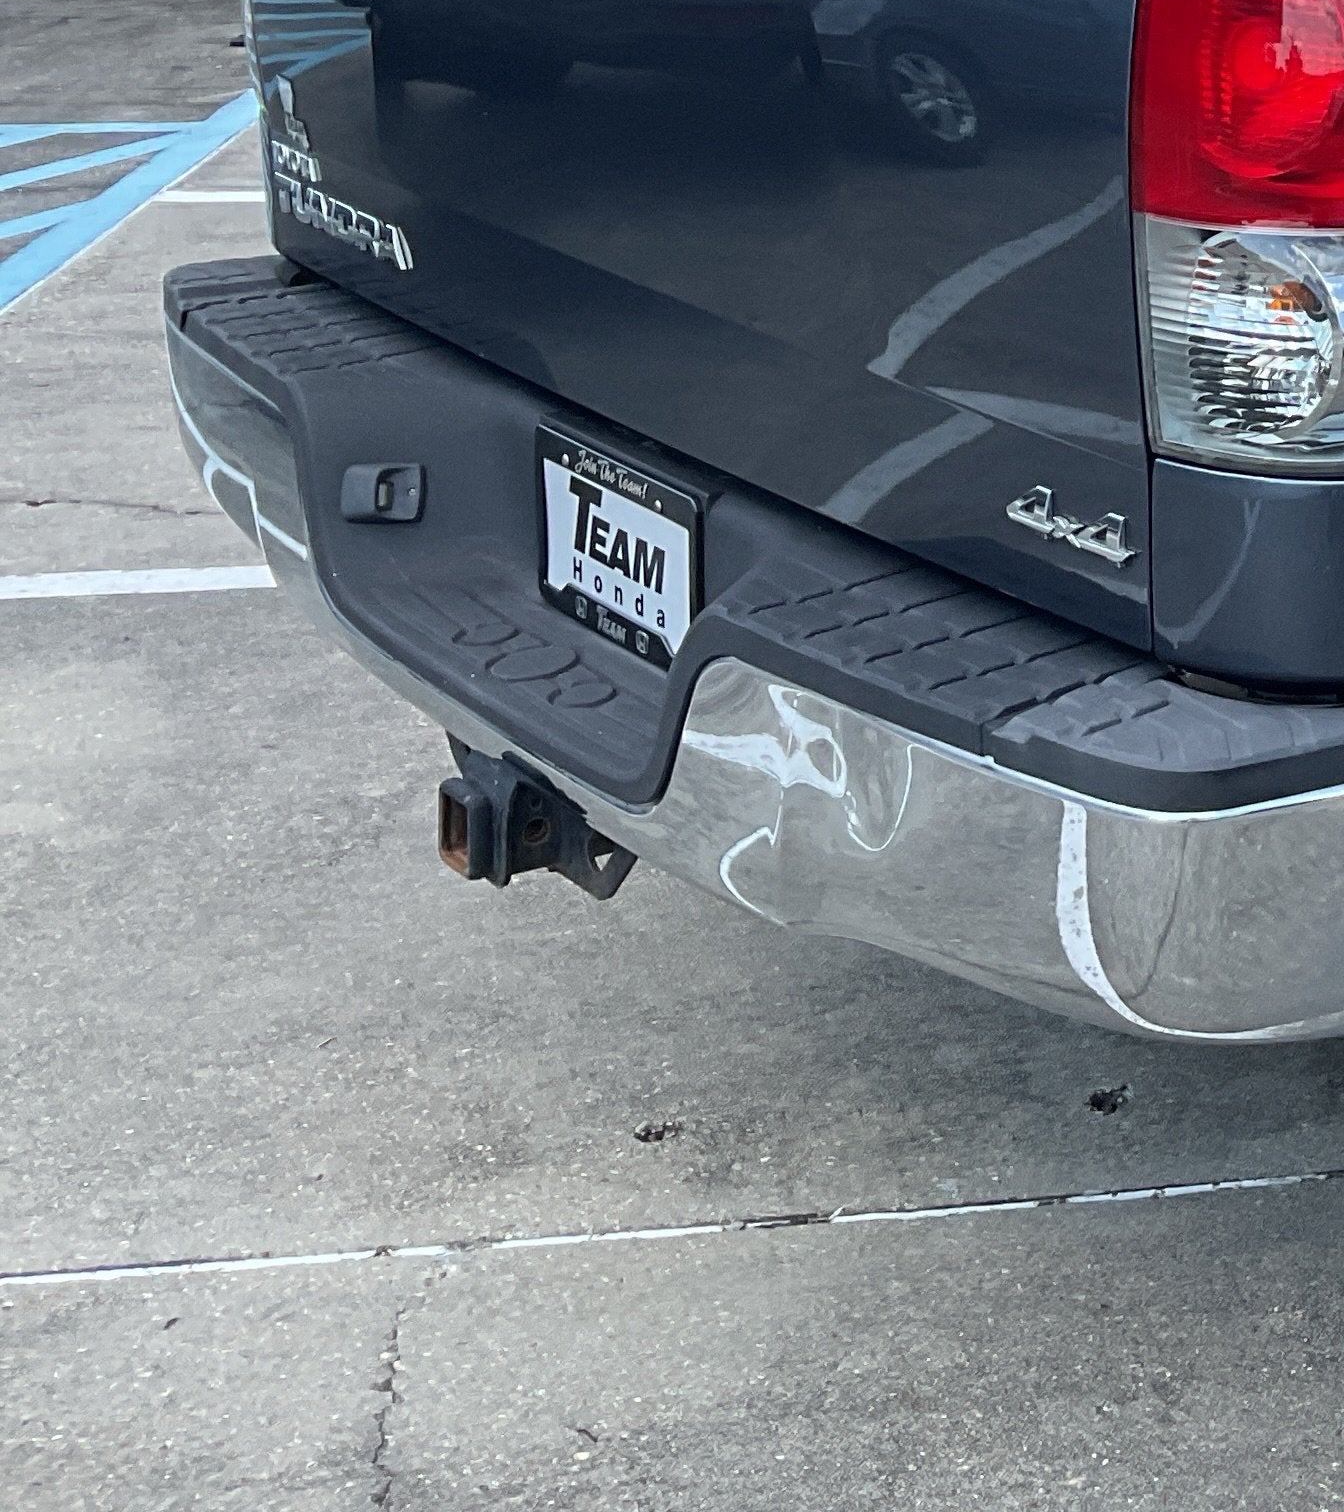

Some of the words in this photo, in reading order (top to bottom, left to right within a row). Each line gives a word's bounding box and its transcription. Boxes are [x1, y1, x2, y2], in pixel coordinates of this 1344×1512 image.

[575, 450, 598, 475] Join
[598, 460, 616, 484] The
[616, 467, 648, 500] Team!
[569, 475, 666, 595] TEAM
[572, 556, 666, 629] Honda
[596, 604, 627, 645] TEAM
